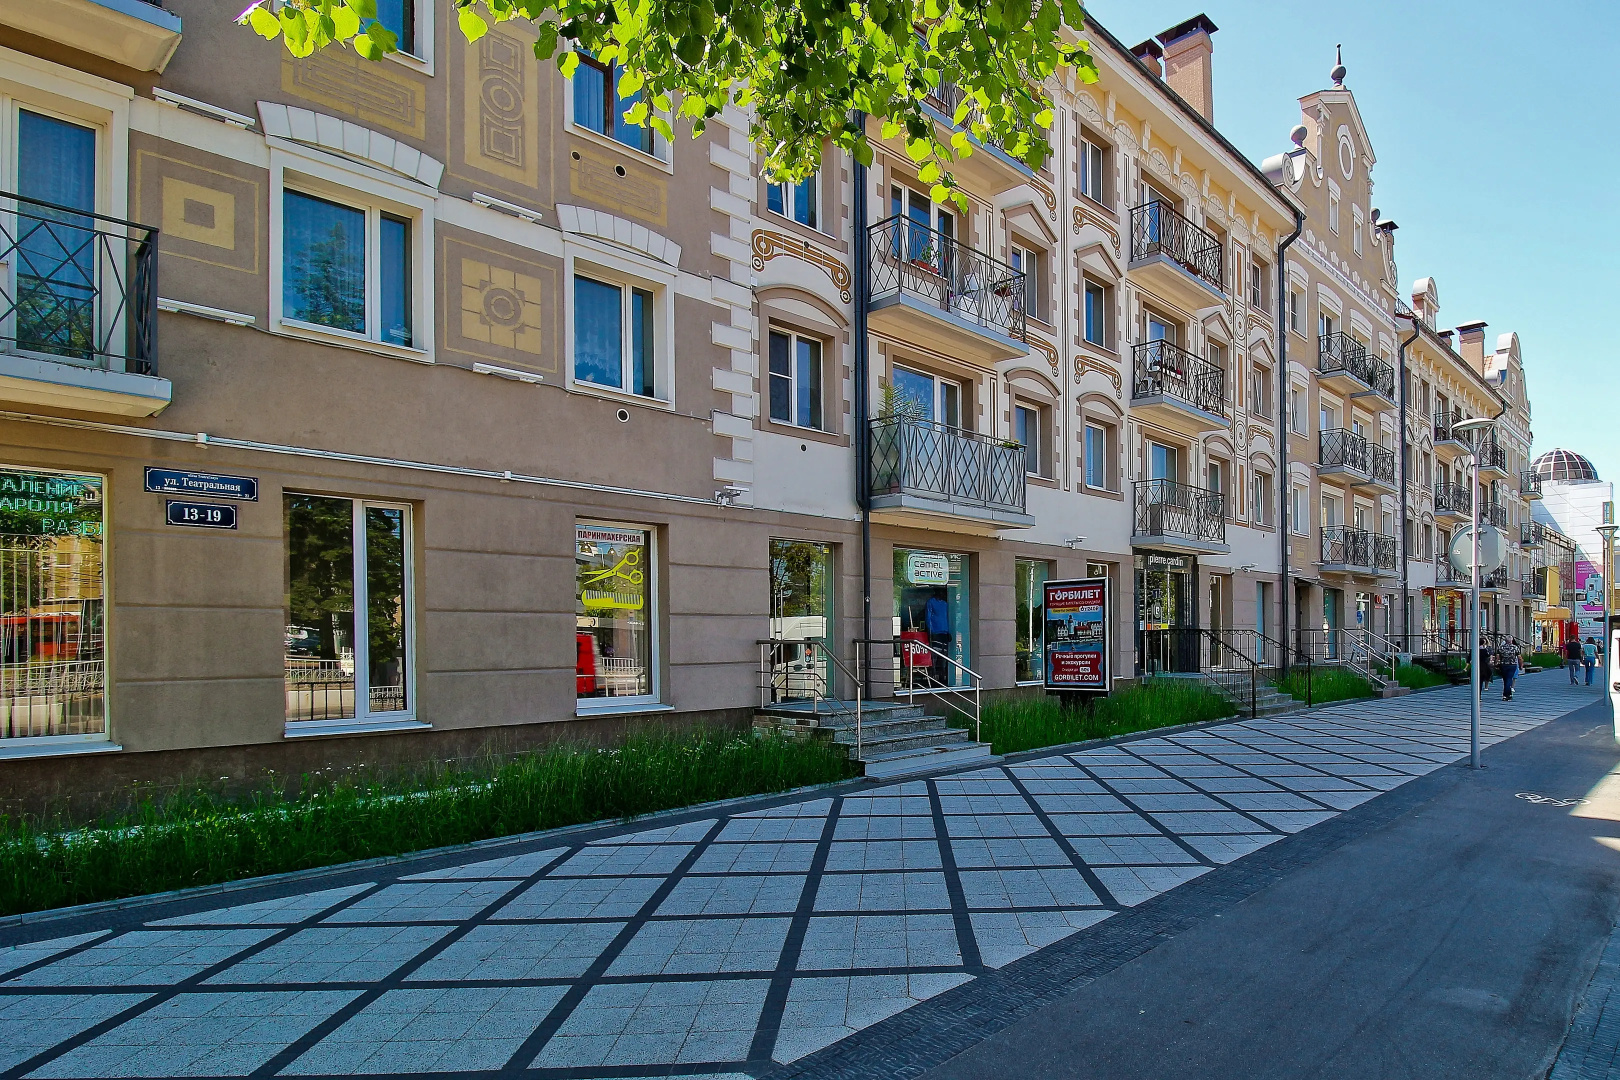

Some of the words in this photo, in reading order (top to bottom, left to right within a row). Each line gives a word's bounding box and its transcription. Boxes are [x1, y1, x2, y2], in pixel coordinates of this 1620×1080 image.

[164, 478, 180, 486] ул.
[182, 478, 241, 492] Театральная
[182, 507, 222, 522] 13-19
[1050, 589, 1100, 601] ГОРБИЛЕТ
